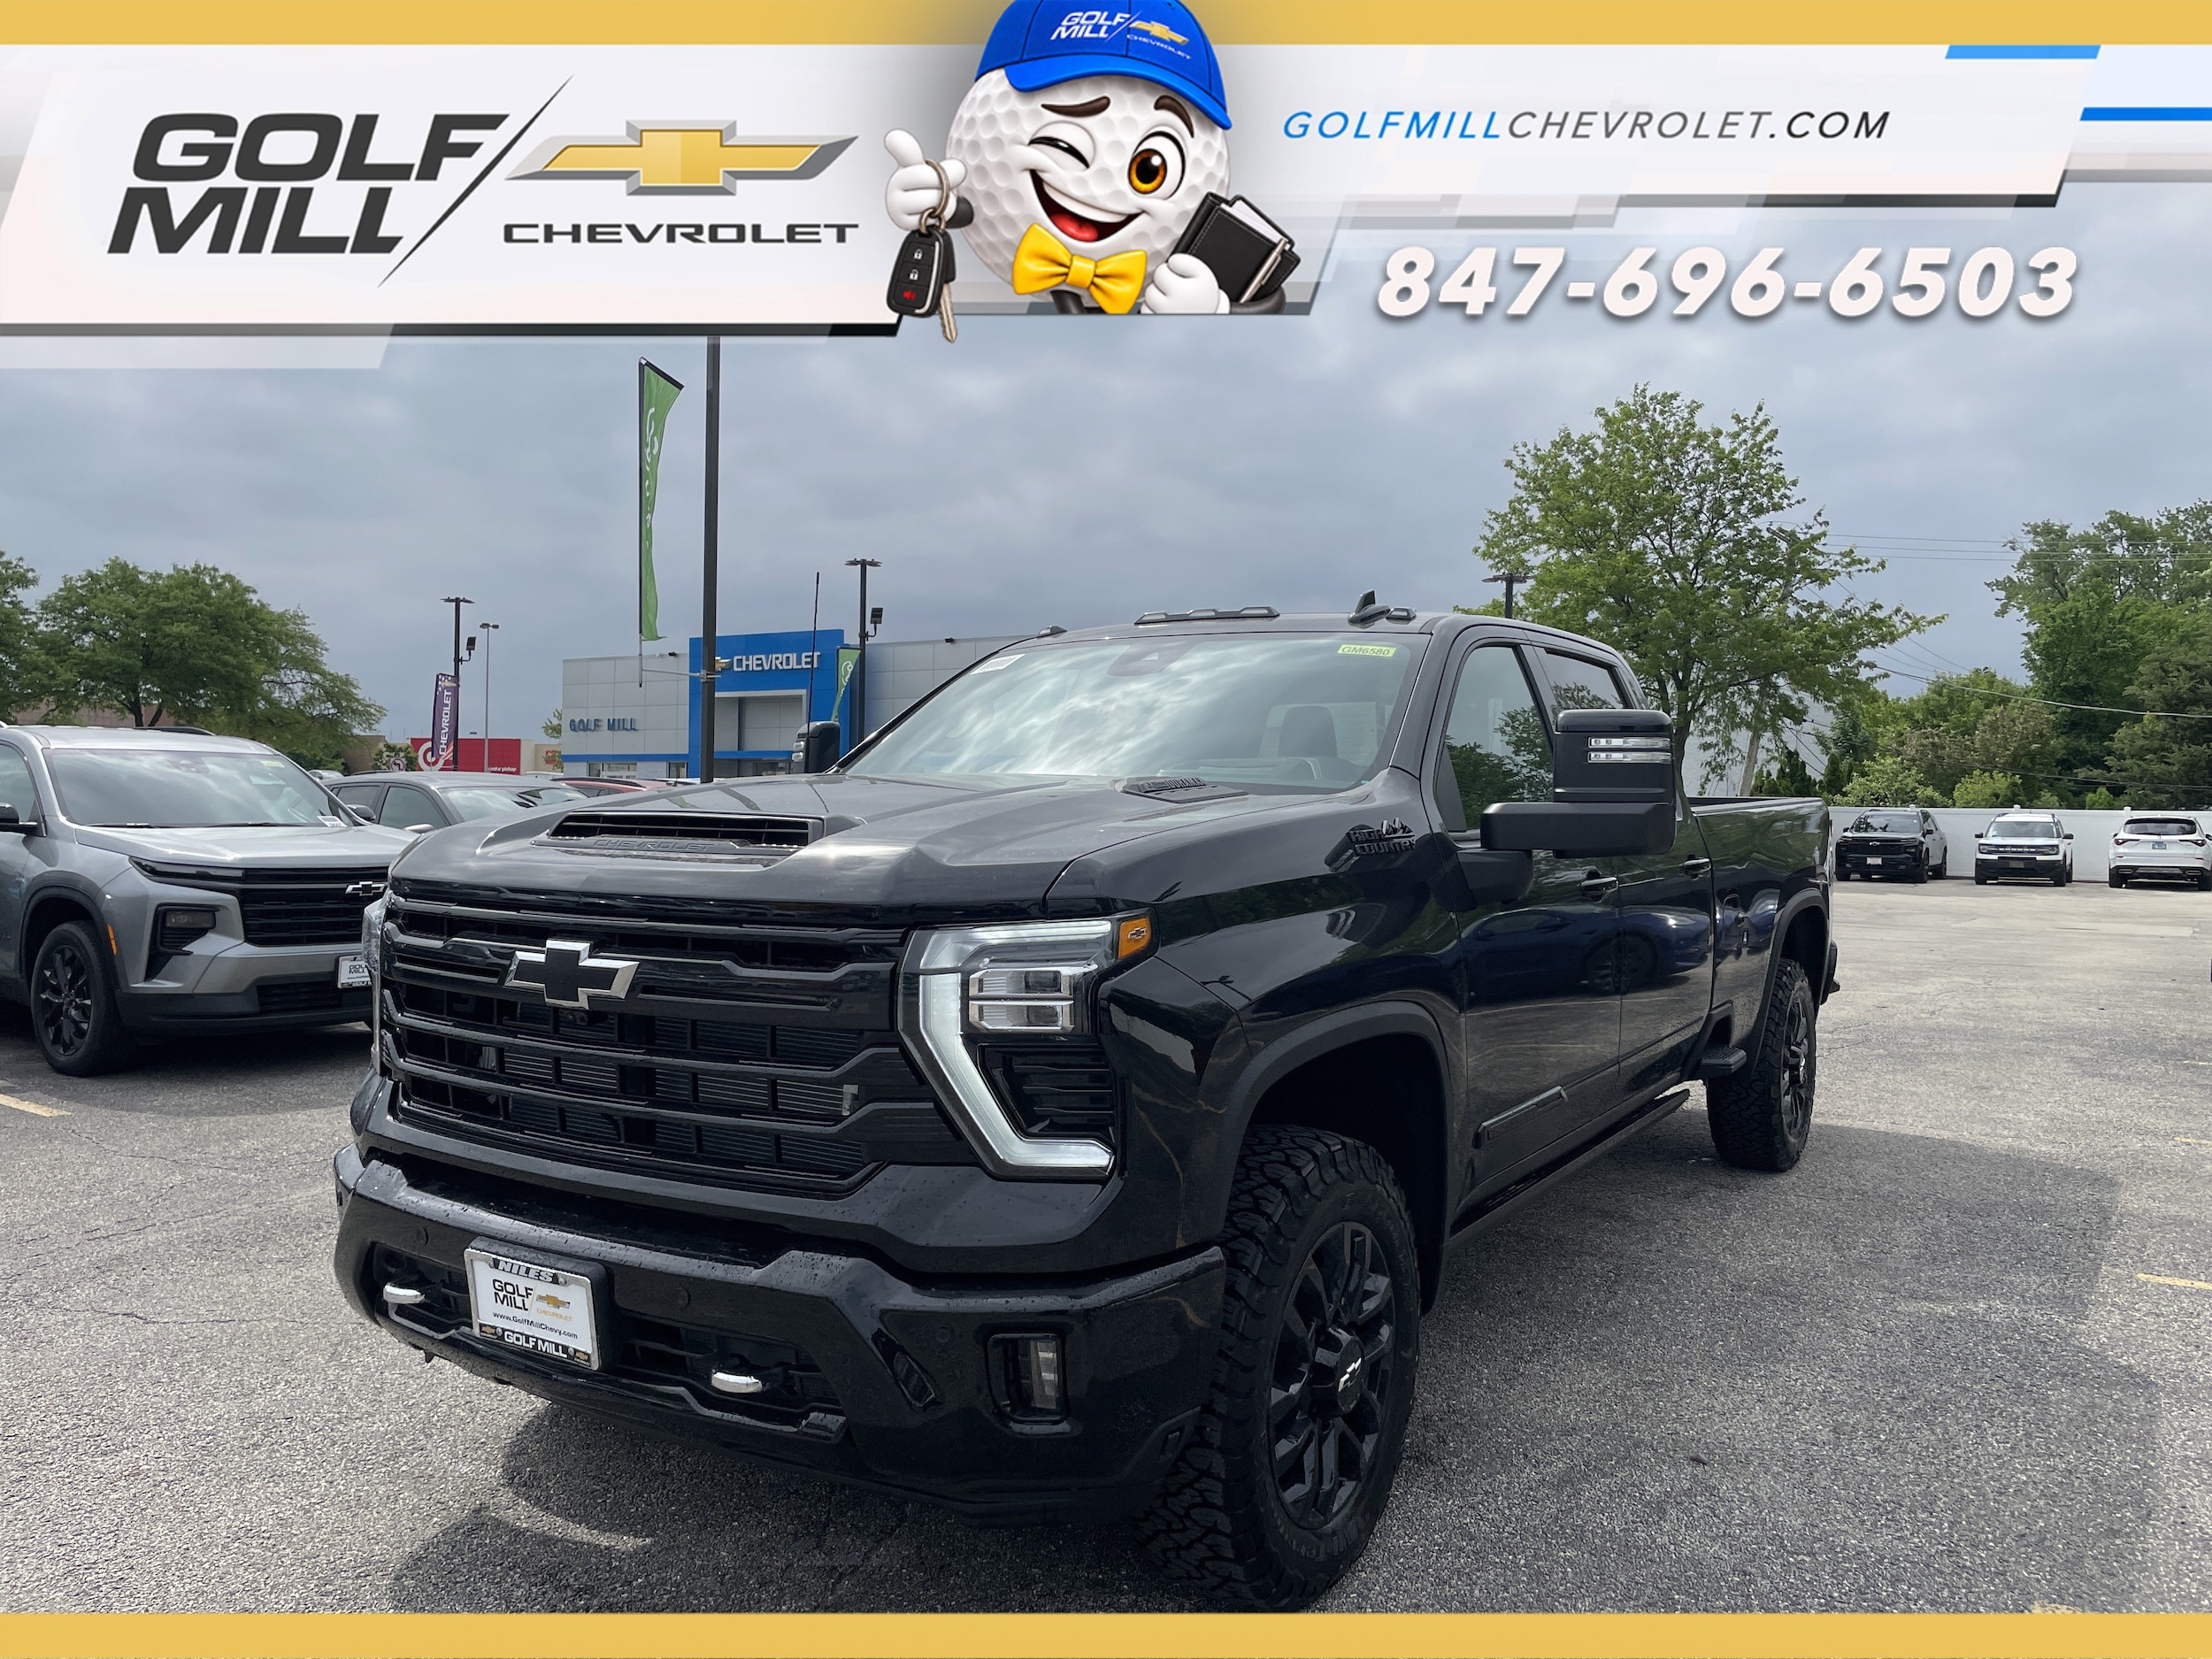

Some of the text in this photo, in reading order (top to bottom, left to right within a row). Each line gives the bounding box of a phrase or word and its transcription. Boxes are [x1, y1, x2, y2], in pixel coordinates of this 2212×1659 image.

[1341, 646, 1391, 656] GM6580
[733, 652, 821, 672] CHEVROLET
[439, 689, 452, 755] CHEVROLET
[569, 718, 639, 732] GOLF MILL
[594, 839, 716, 851] CHEVROLET
[498, 1260, 554, 1282] NILES
[493, 1279, 533, 1299] GOLF
[495, 1292, 528, 1311] MILL
[493, 1311, 578, 1340] www.GolfMillChevy.com
[503, 1330, 536, 1349] GOLF
[538, 1339, 567, 1358] MILL
